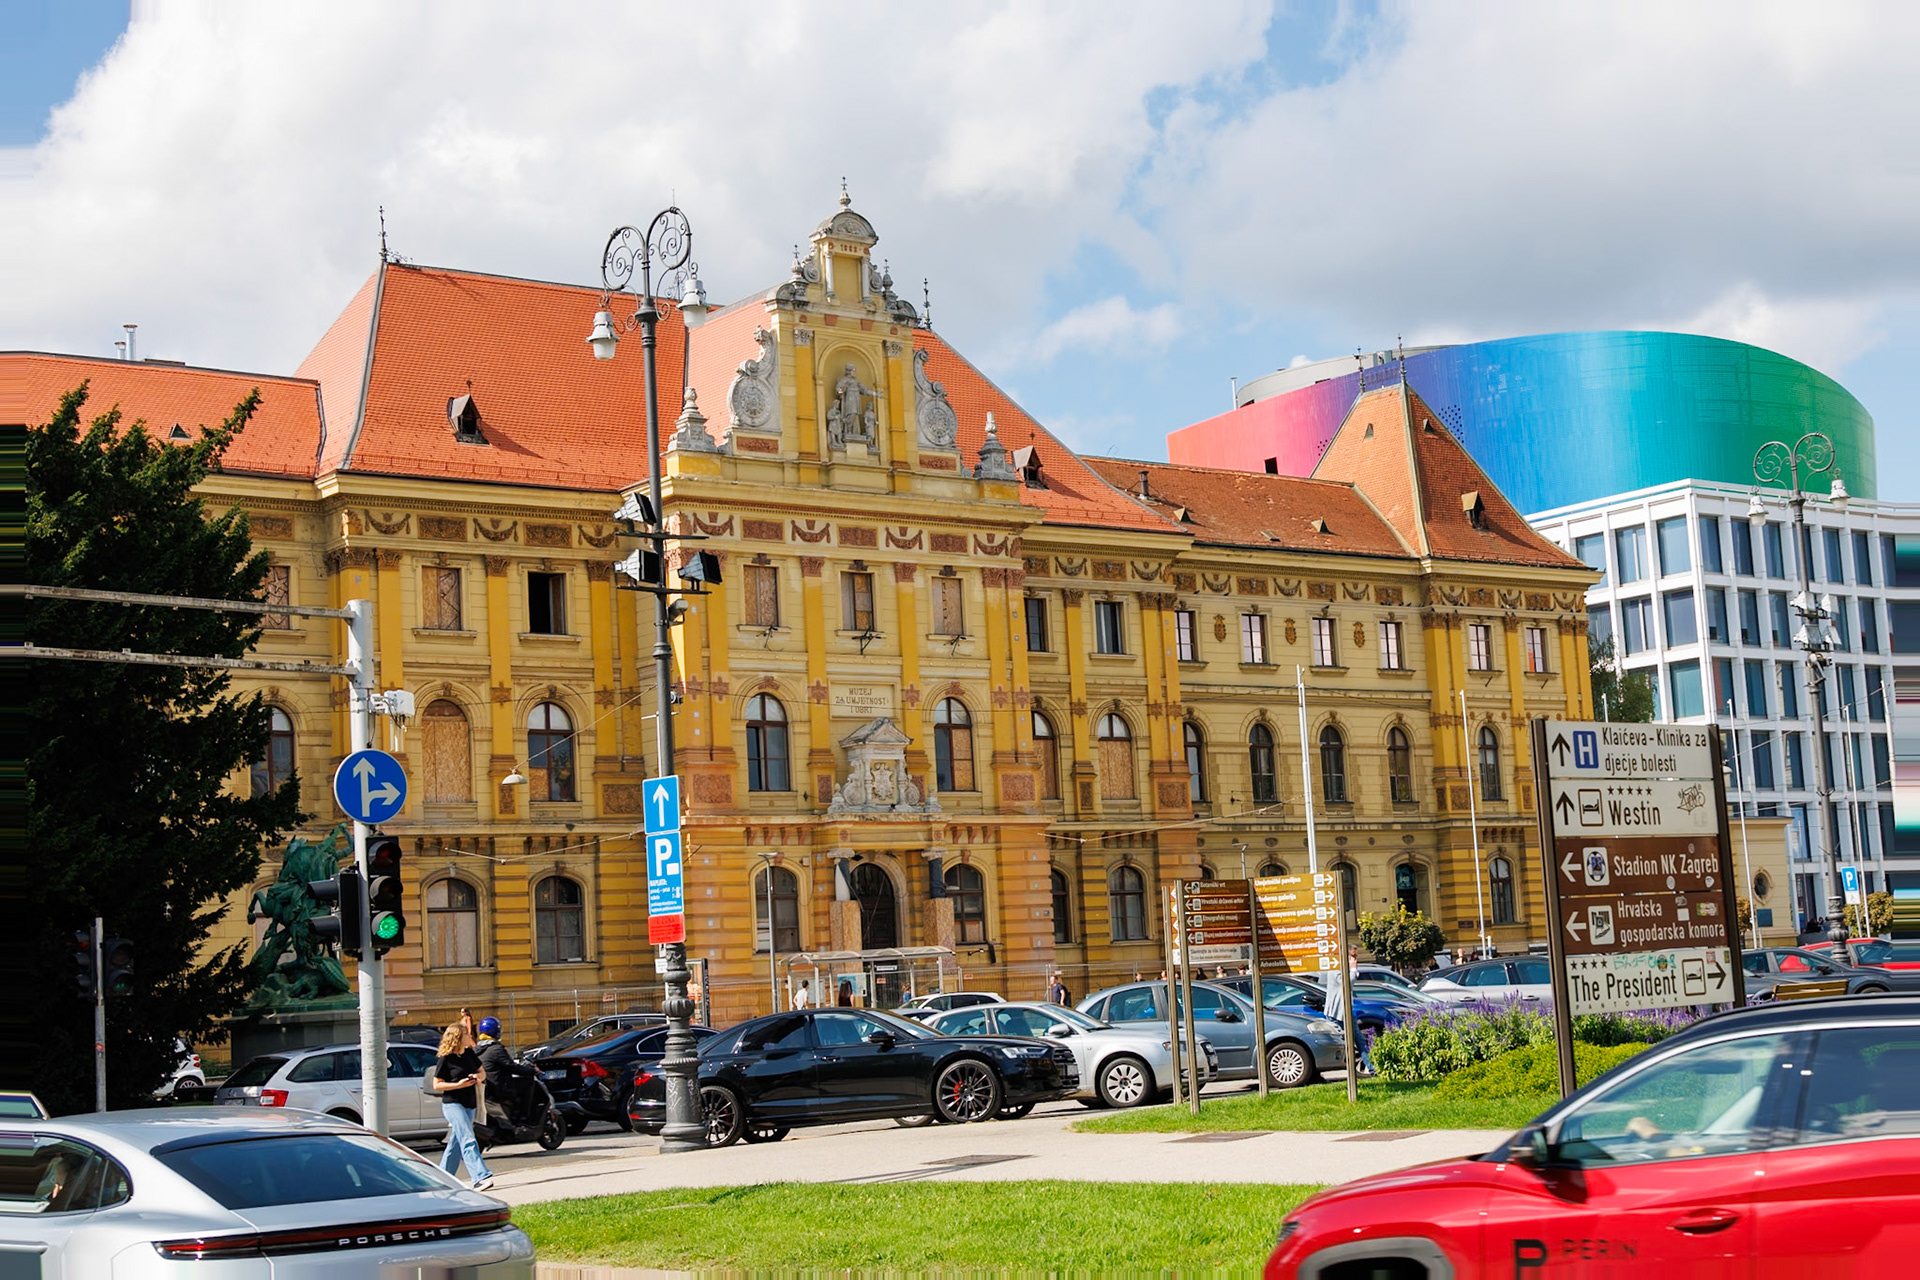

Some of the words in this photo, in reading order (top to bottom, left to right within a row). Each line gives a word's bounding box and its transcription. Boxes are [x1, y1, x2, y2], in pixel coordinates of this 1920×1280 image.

[1602, 728, 1647, 746] Klaićeva
[1656, 729, 1690, 746] Klinika
[1695, 734, 1706, 746] za
[1606, 754, 1637, 776] dječje
[1641, 754, 1676, 771] bolesti
[1608, 800, 1661, 826] Westin
[655, 838, 672, 876] P
[1614, 855, 1658, 876] Stadion
[1661, 855, 1677, 874] NK
[1680, 853, 1718, 878] Zagreb
[1846, 871, 1853, 888] P
[1618, 899, 1662, 918] Hrvatska
[1620, 925, 1684, 947] gospodarska
[1688, 922, 1724, 939] komora
[1571, 976, 1600, 1002] The
[1606, 970, 1677, 999] President
[338, 1228, 450, 1246] PORSCHE
[1514, 1239, 1548, 1280] P
